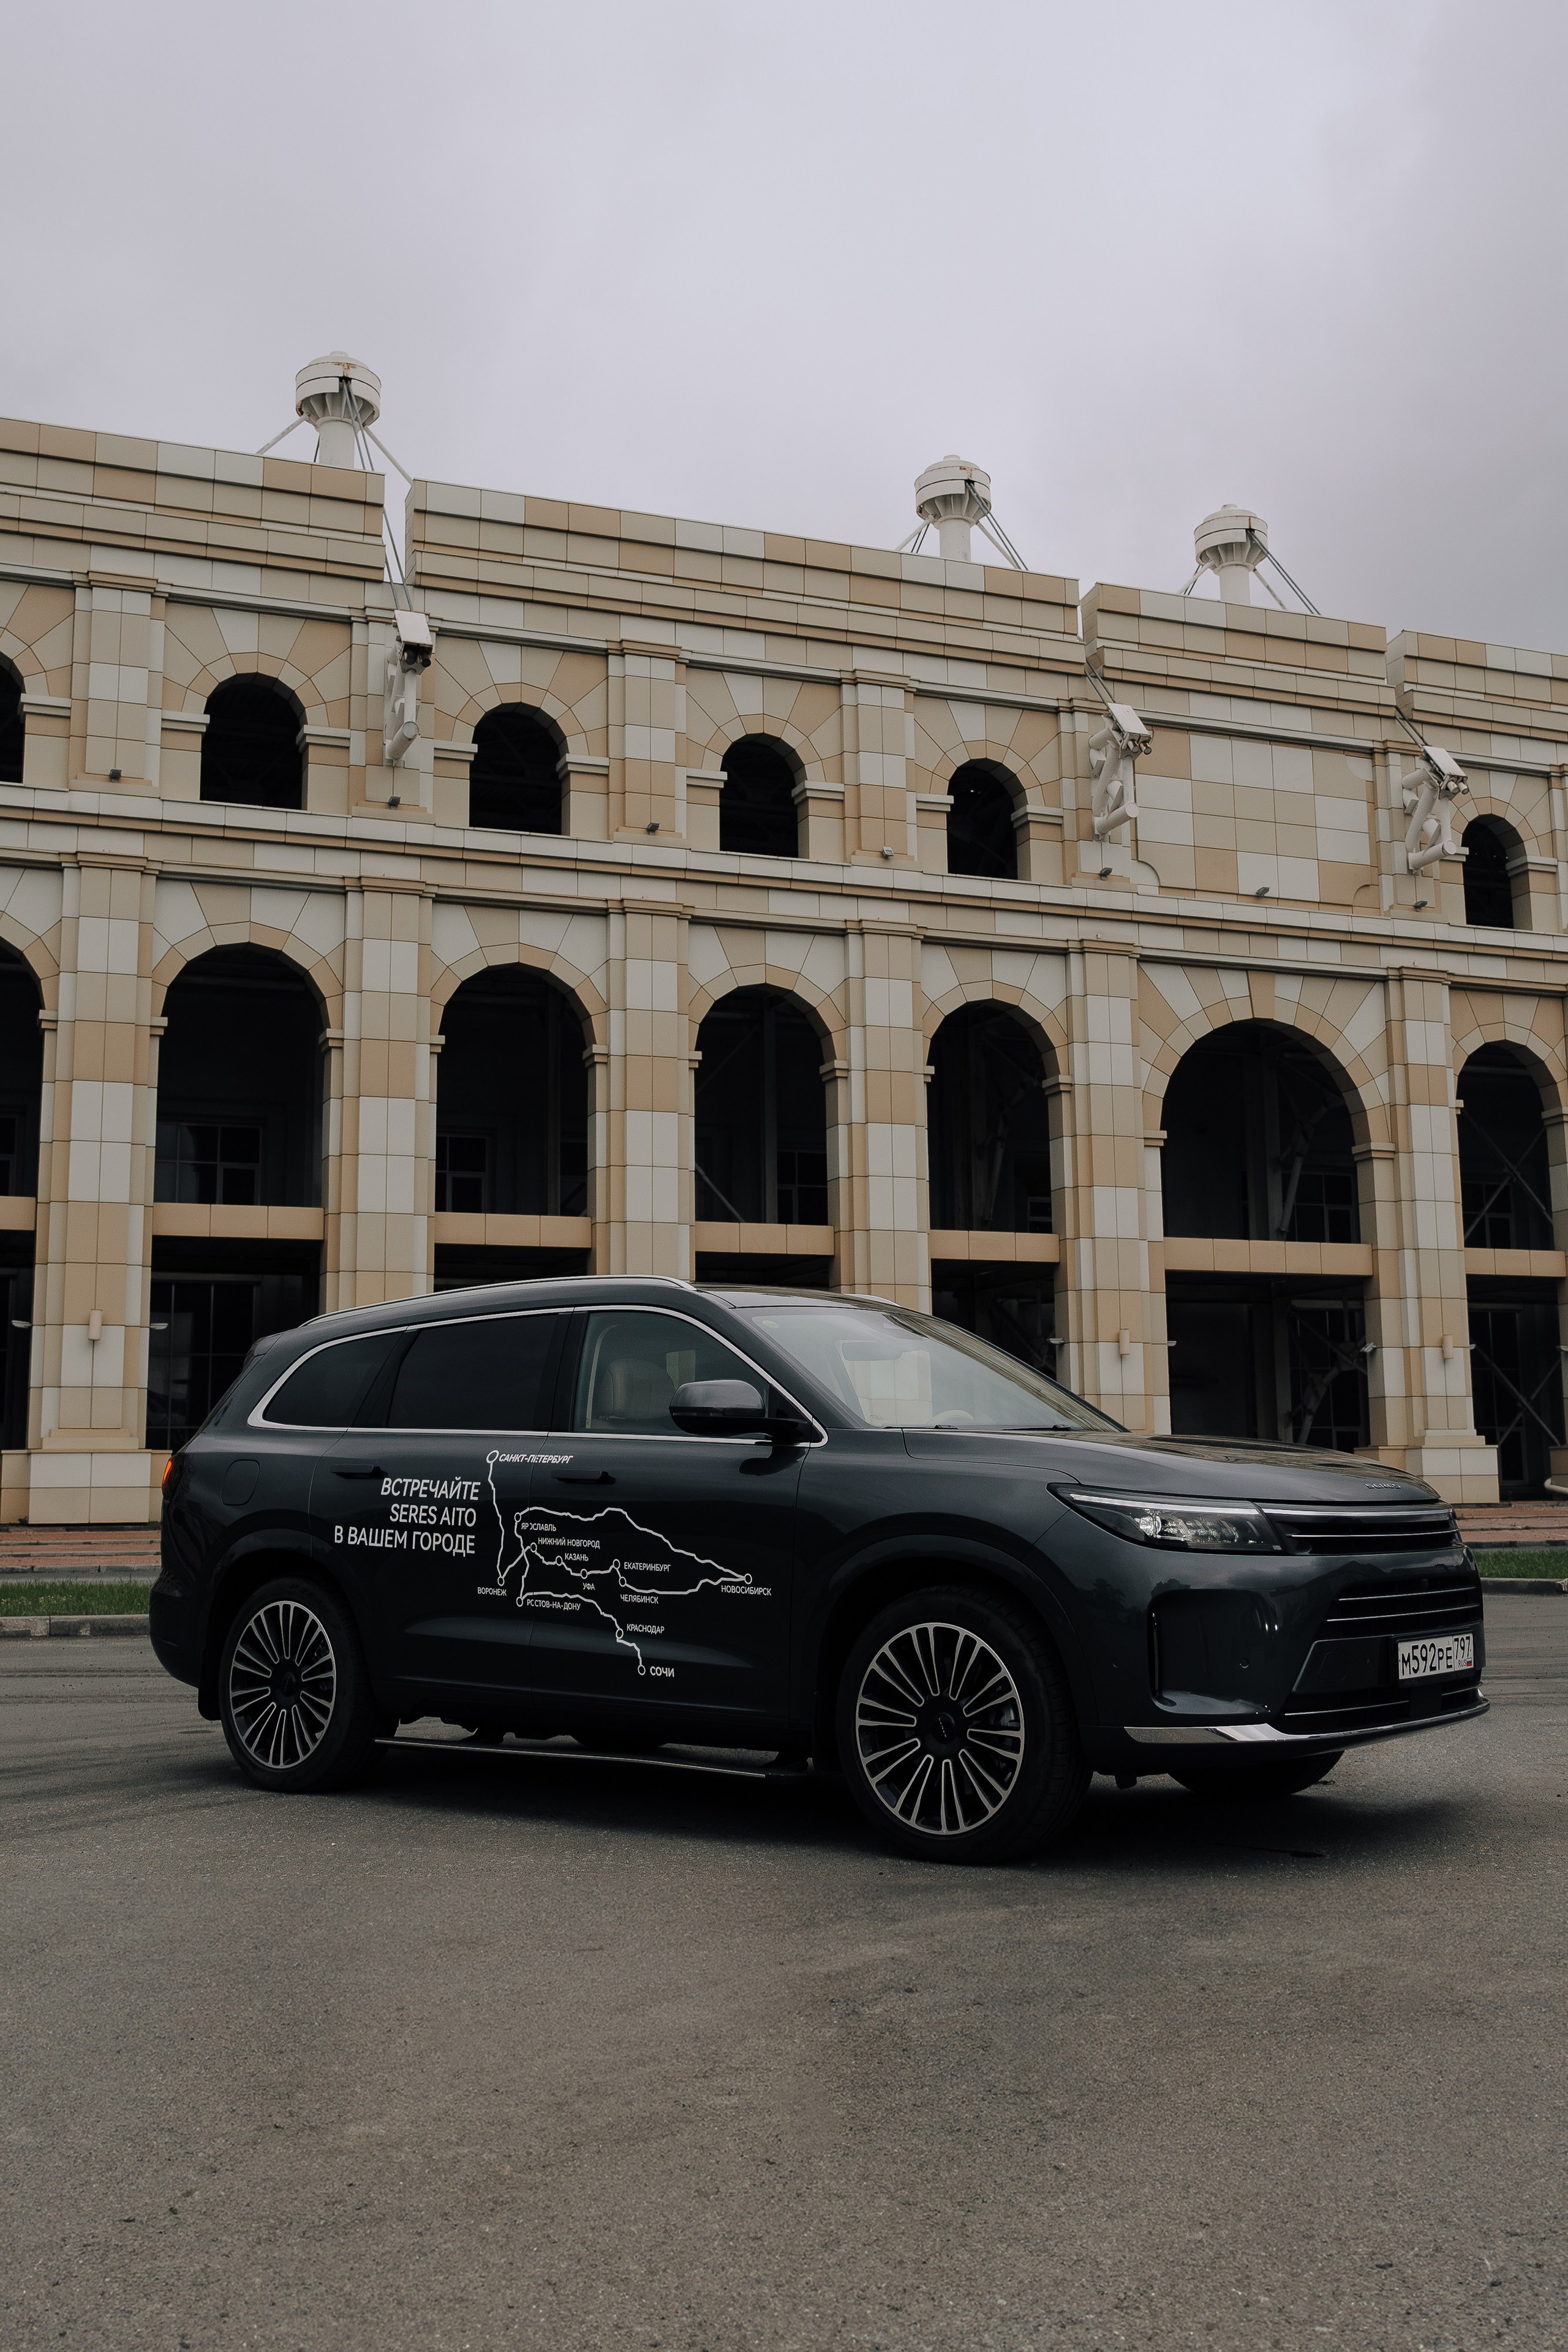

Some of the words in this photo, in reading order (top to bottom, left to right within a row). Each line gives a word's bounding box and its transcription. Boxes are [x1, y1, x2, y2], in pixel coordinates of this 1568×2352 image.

[499, 1453, 573, 1463] САНКТ-ПЕТЕРБУРГ
[381, 1477, 480, 1500] ВСТРЕЧАЙТЕ
[390, 1504, 437, 1524] SERES
[440, 1507, 476, 1526] AITO
[335, 1526, 343, 1543] В
[348, 1527, 407, 1548] ВАШЕМ
[413, 1532, 475, 1557] ГОРОДЕ
[567, 1539, 600, 1549] НОВГОРОД
[624, 1562, 671, 1572] ЕКАТЕРИНБУРГ
[478, 1587, 507, 1596] ВОРОНЕЖ
[722, 1585, 771, 1596] НОВОСИБИРСК
[620, 1594, 658, 1604] ЧЕЛЯБИНСК
[627, 1624, 665, 1634] КРАСНОДАР
[1454, 1636, 1471, 1659] 797
[650, 1666, 674, 1677] СОЧИ
